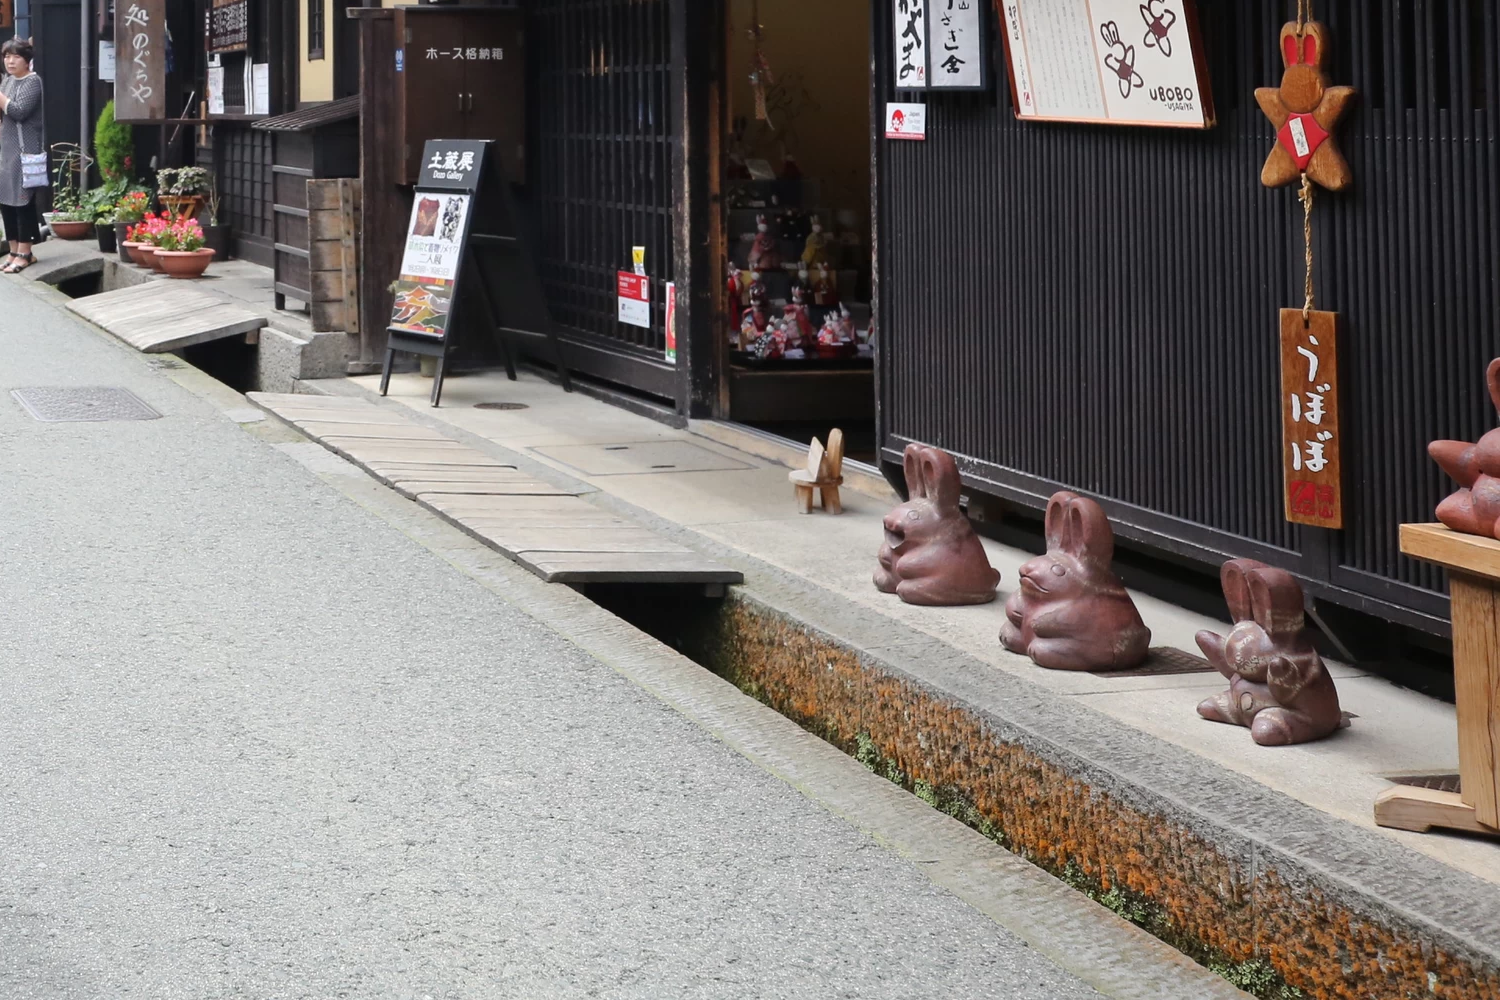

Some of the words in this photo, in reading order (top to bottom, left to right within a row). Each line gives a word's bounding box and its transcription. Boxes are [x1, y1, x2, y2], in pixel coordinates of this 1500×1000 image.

[425, 47, 504, 61] ホース格納箱
[1149, 86, 1194, 102] UBOBO
[427, 151, 475, 171] 土蔵展
[446, 170, 464, 182] Gallery
[1292, 334, 1333, 473] うぼぼ
